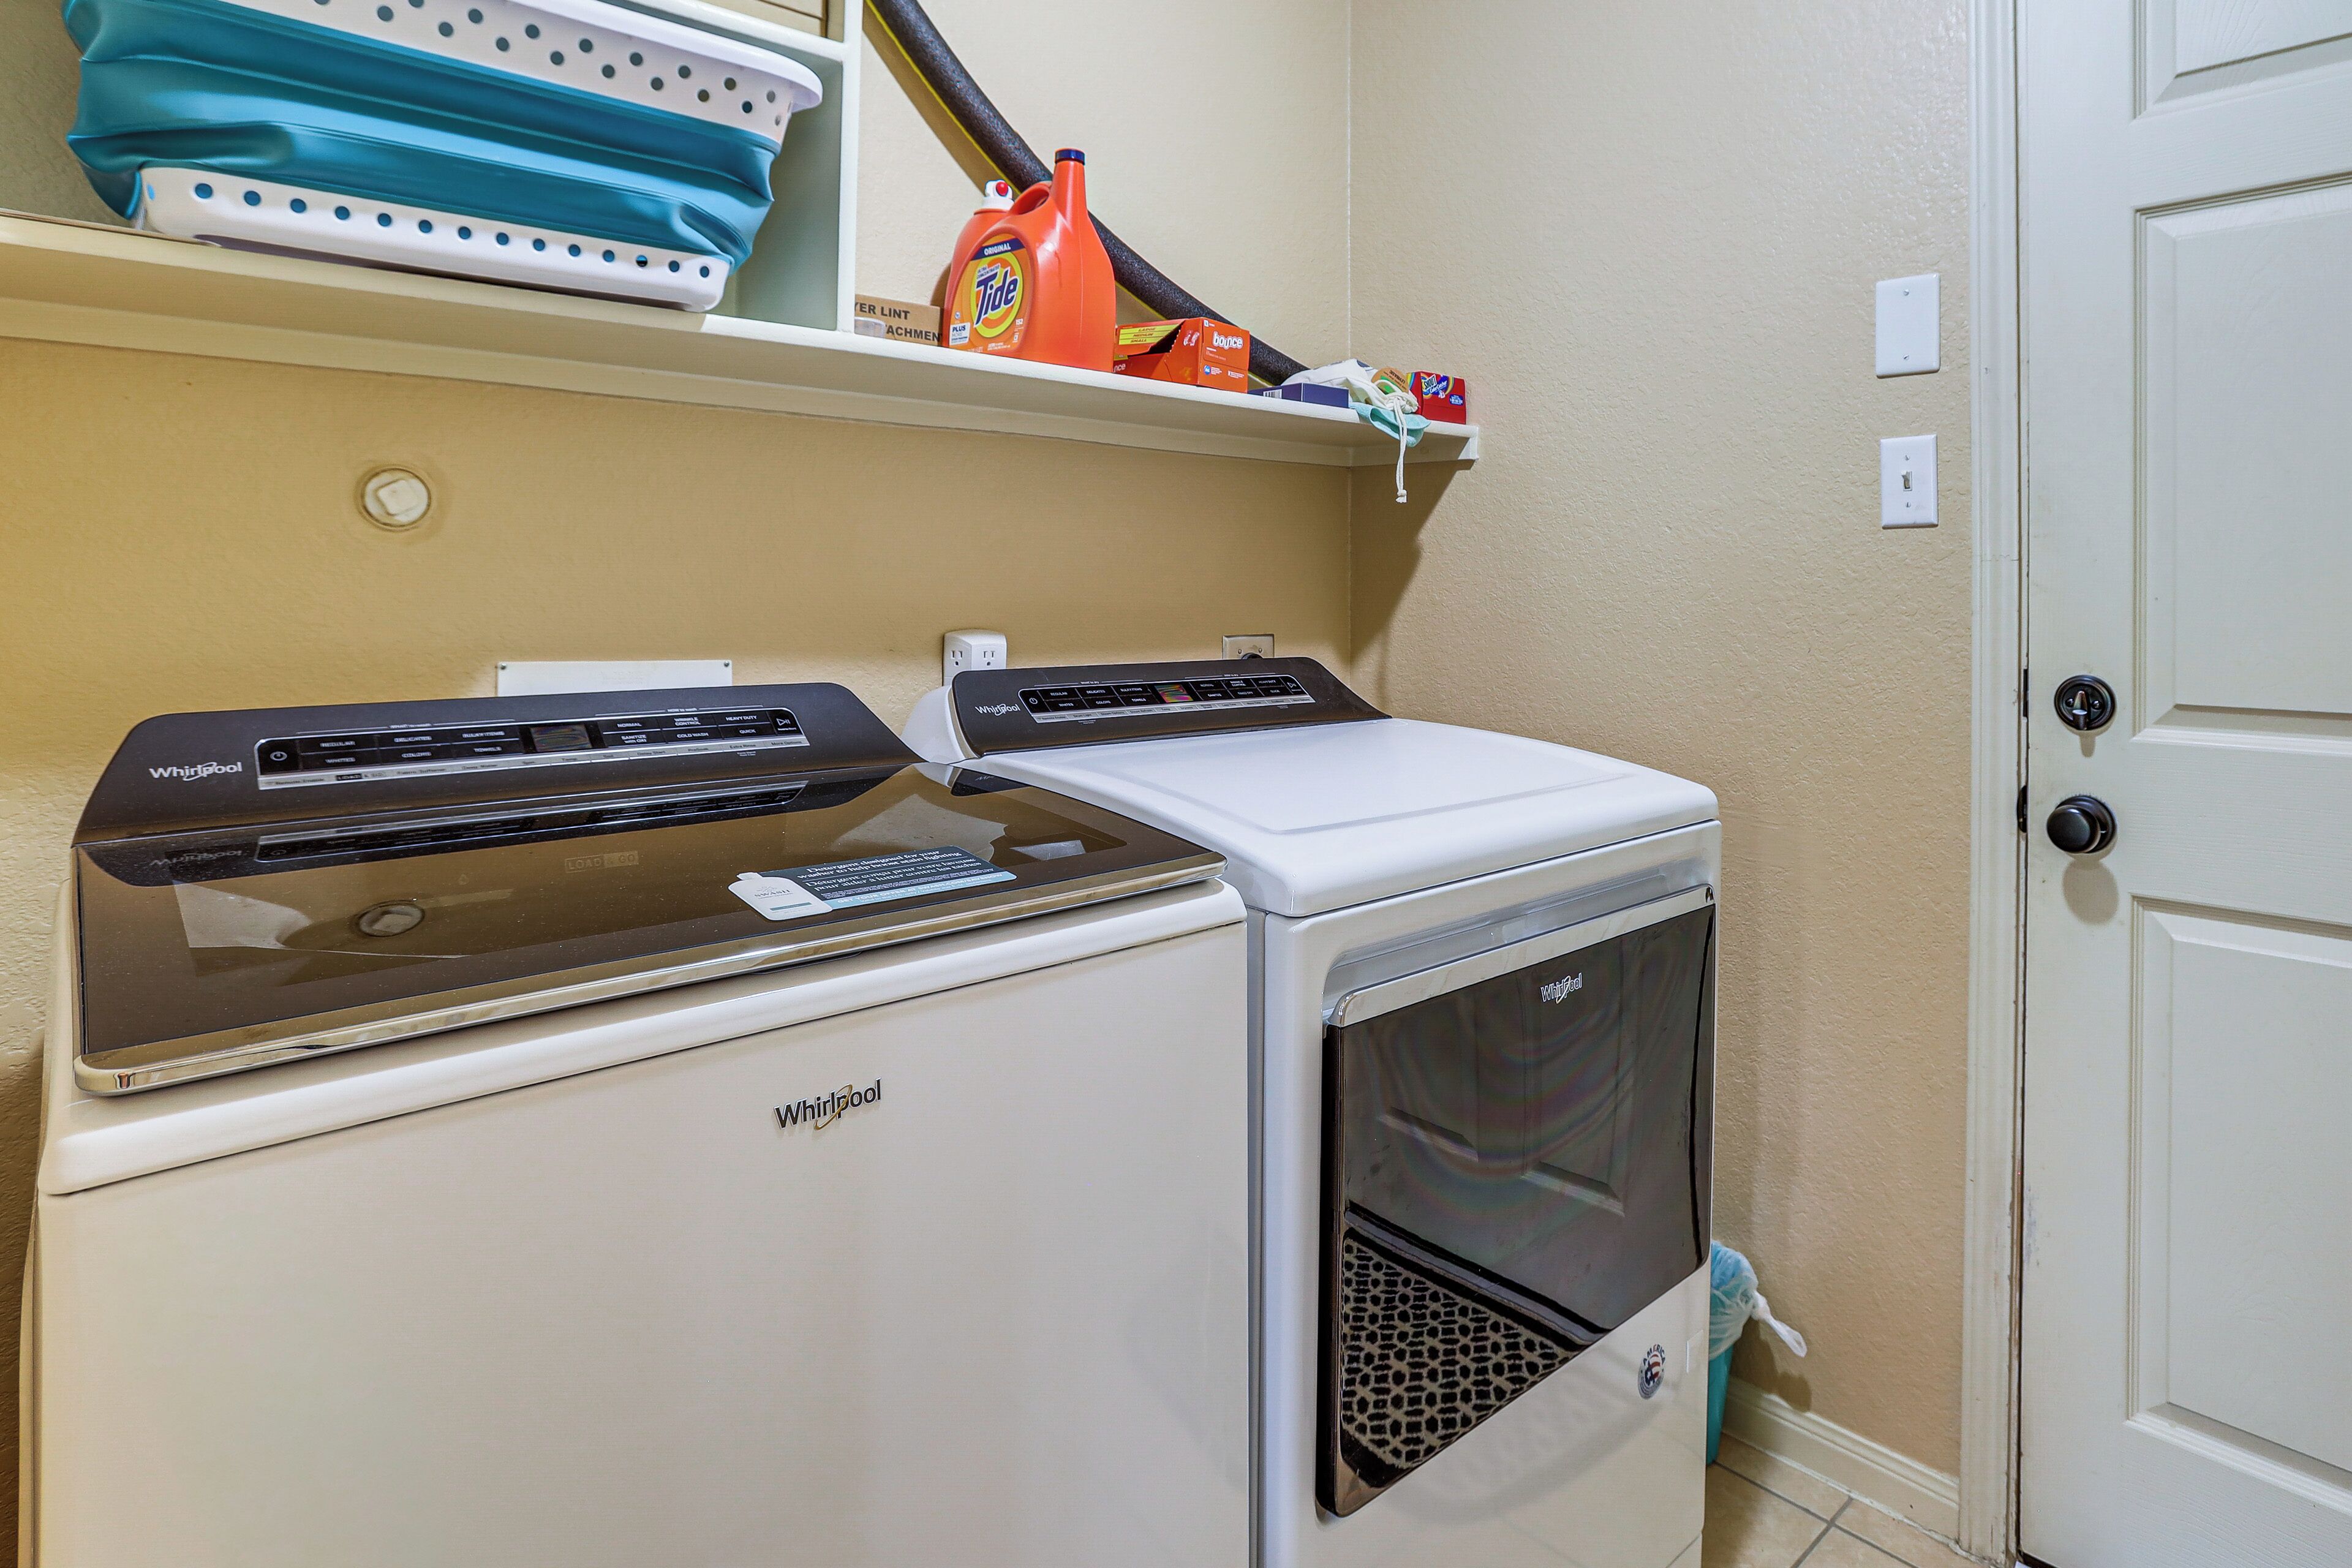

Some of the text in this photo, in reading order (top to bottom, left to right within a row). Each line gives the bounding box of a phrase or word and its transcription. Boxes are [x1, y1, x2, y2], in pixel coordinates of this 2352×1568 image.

[984, 243, 1011, 255] ORIGINAL
[975, 268, 1019, 326] Tide
[881, 306, 911, 320] LINT
[886, 323, 942, 342] ACHMEN
[1213, 331, 1243, 350] bounce
[1114, 363, 1126, 373] nce
[975, 704, 1020, 716] Whirlpool
[149, 762, 243, 781] Whirlpool
[568, 858, 601, 870] LOAD
[618, 854, 635, 864] GO
[797, 870, 835, 880] washer
[870, 861, 900, 869] boost
[923, 852, 962, 861] fighting
[807, 861, 861, 873] Detergent
[860, 854, 904, 867] designed
[941, 858, 976, 867] laveuse
[814, 883, 839, 892] pour
[876, 873, 905, 882] lutter
[754, 889, 791, 898] SWASH
[1540, 973, 1583, 1005] Whirlpool
[774, 1077, 881, 1130] Whirlpool
[1643, 1344, 1666, 1366] AMERICA
